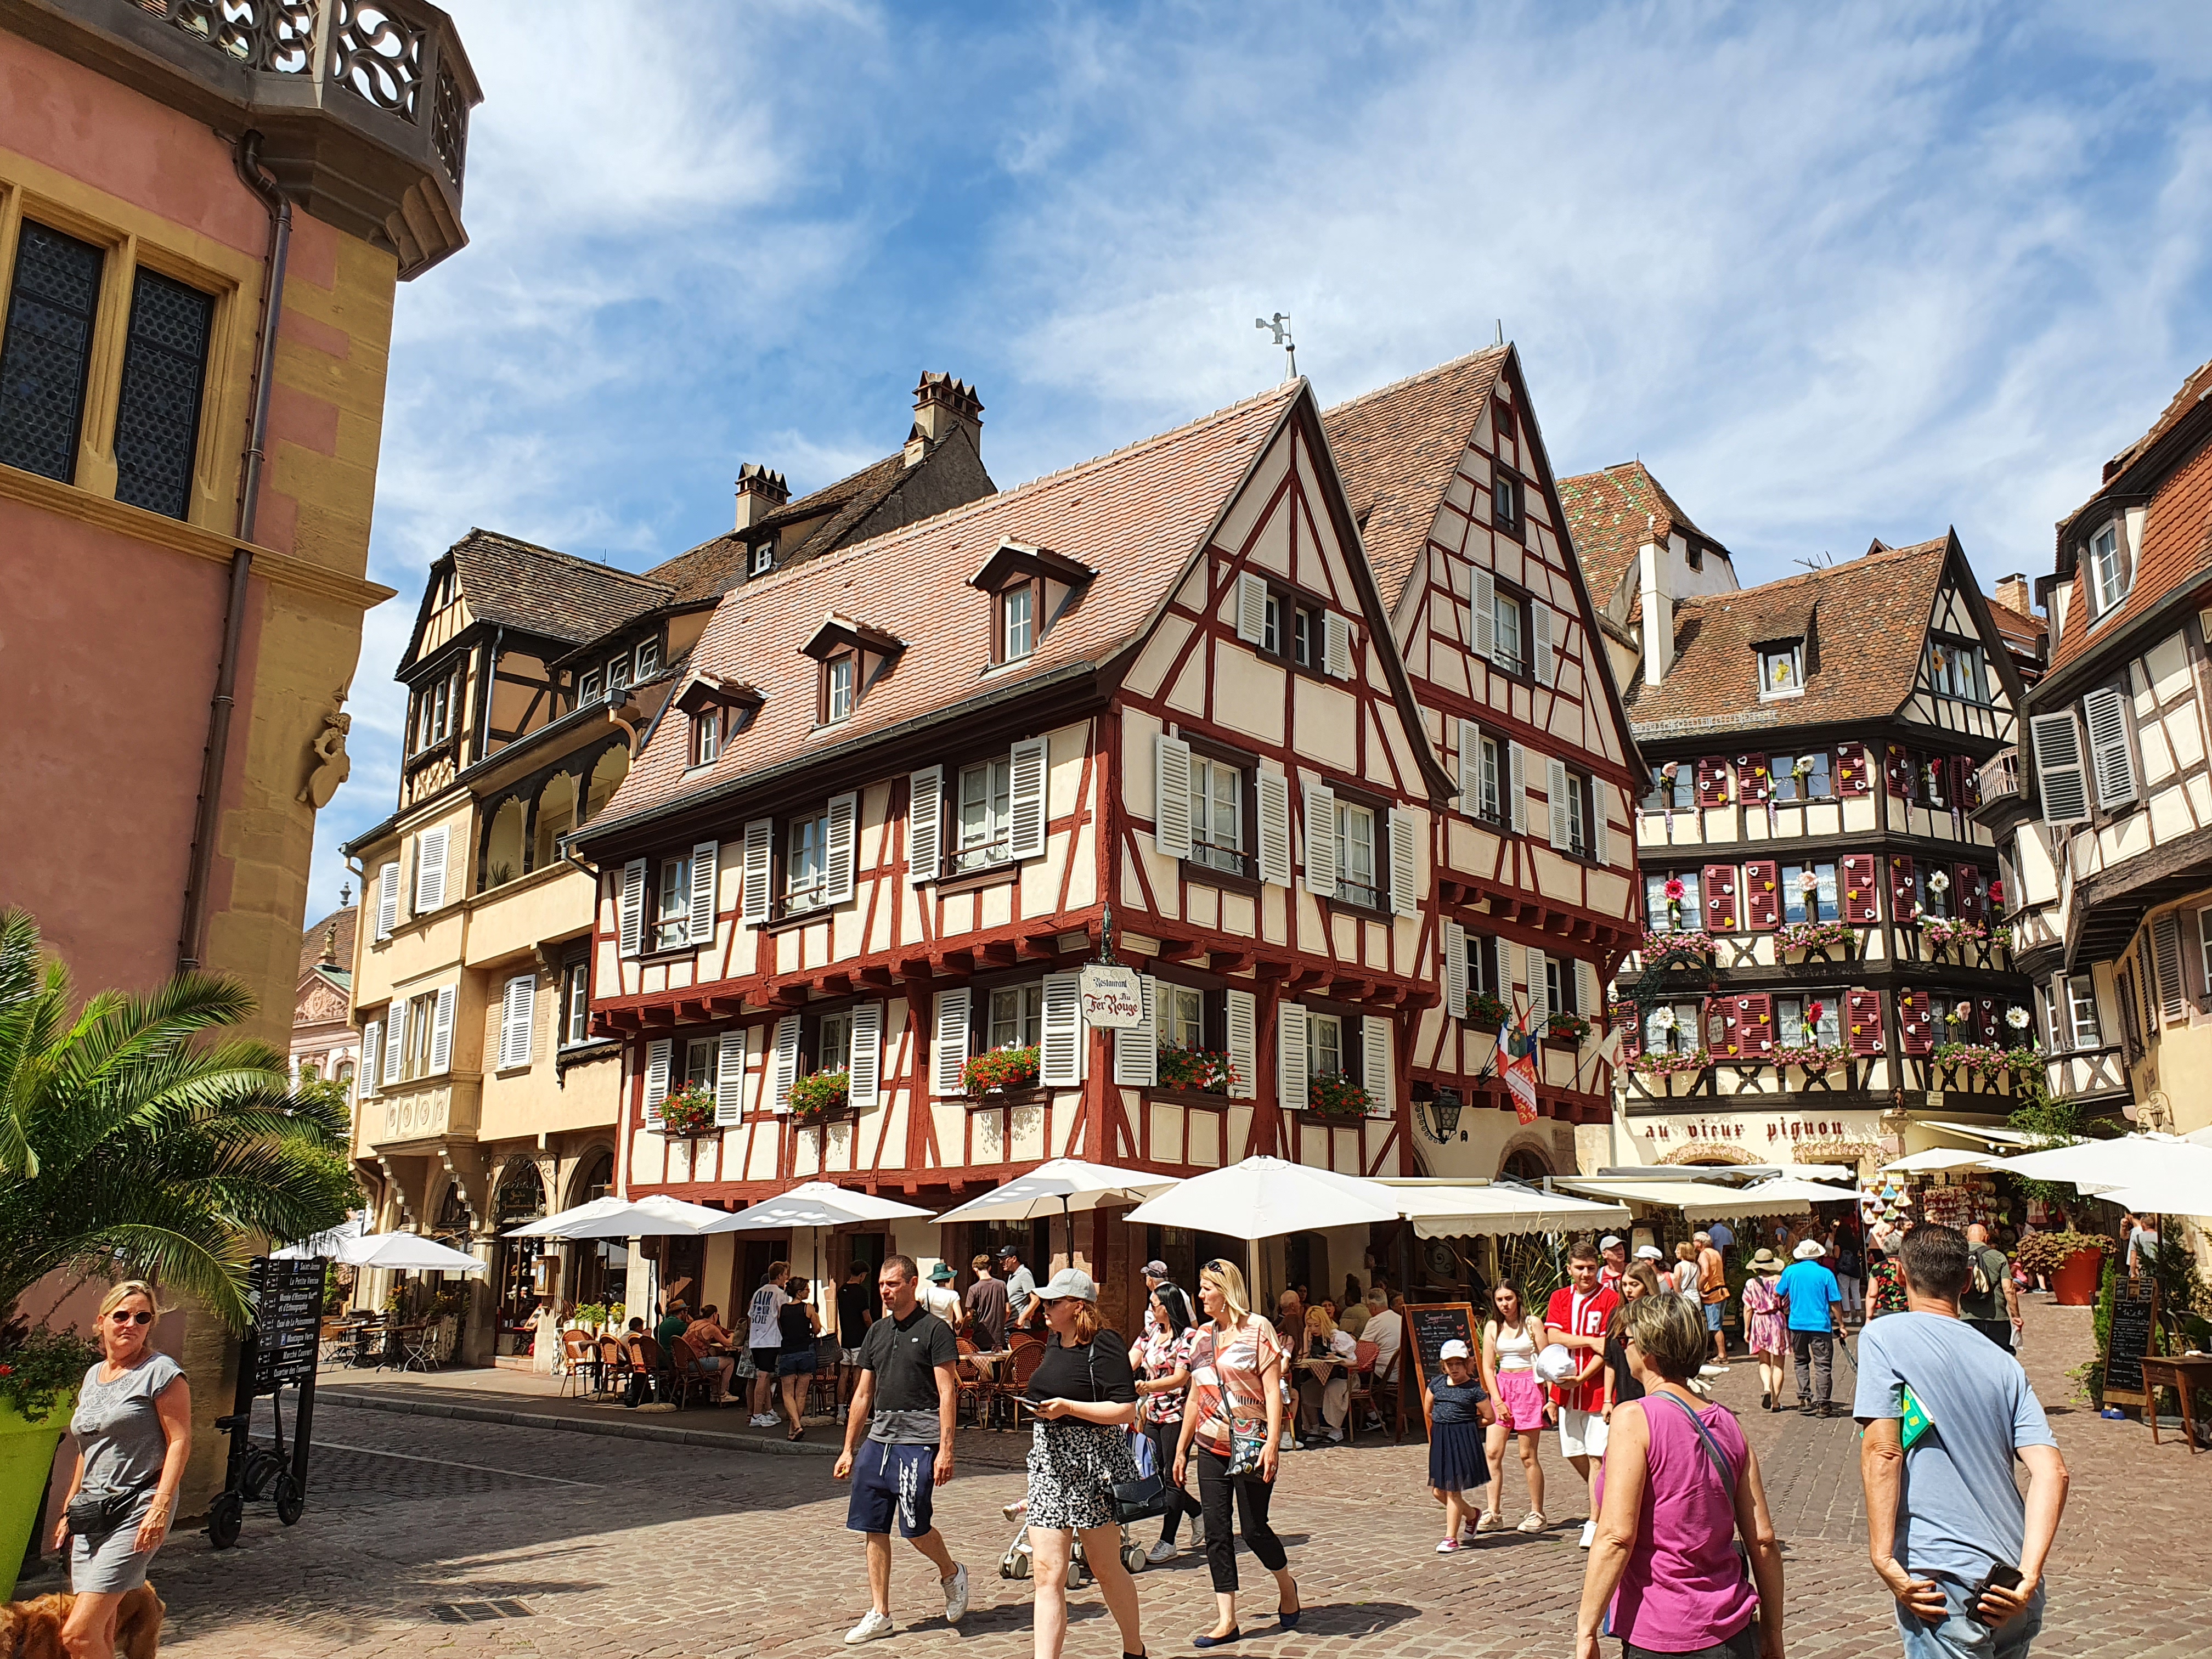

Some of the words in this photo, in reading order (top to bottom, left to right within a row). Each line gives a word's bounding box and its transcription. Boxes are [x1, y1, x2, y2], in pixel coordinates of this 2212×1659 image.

[1093, 977, 1127, 988] Restaurant
[1119, 992, 1131, 1001] Au
[1083, 994, 1105, 1015] Fer
[1104, 993, 1138, 1017] Rouge
[1646, 1125, 1668, 1138] au
[1687, 1118, 1744, 1138] vieux
[1767, 1116, 1843, 1142] pignon
[754, 1290, 774, 1306] AIR
[752, 1314, 768, 1324] SOLE
[283, 1350, 297, 1359] Marché
[298, 1348, 313, 1357] Couvert
[274, 1368, 289, 1377] Quartier
